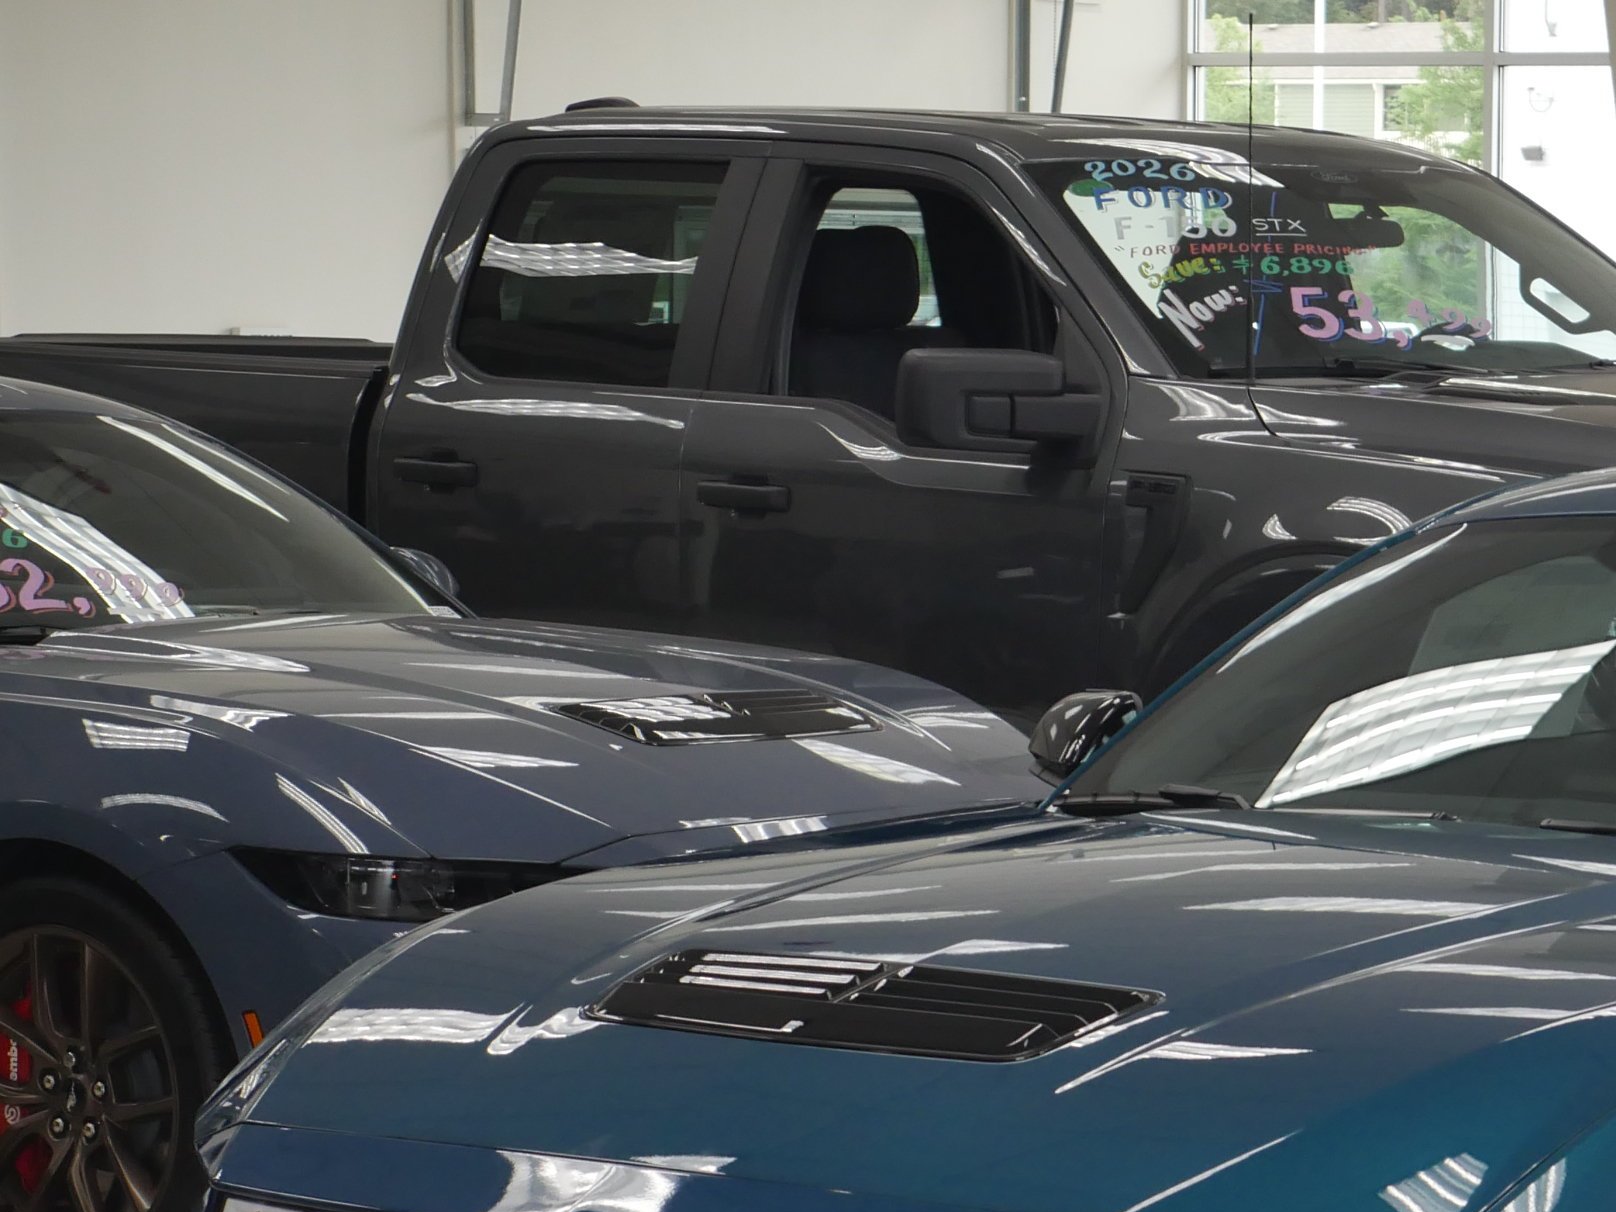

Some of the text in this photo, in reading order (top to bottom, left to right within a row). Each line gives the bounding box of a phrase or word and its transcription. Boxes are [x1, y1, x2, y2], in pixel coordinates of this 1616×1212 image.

[1084, 159, 1196, 182] 2026
[1093, 185, 1233, 213] FORD
[1114, 215, 1307, 239] F-150 STX
[1190, 243, 1284, 256] EMPLOYEE
[1158, 285, 1249, 351] Now:
